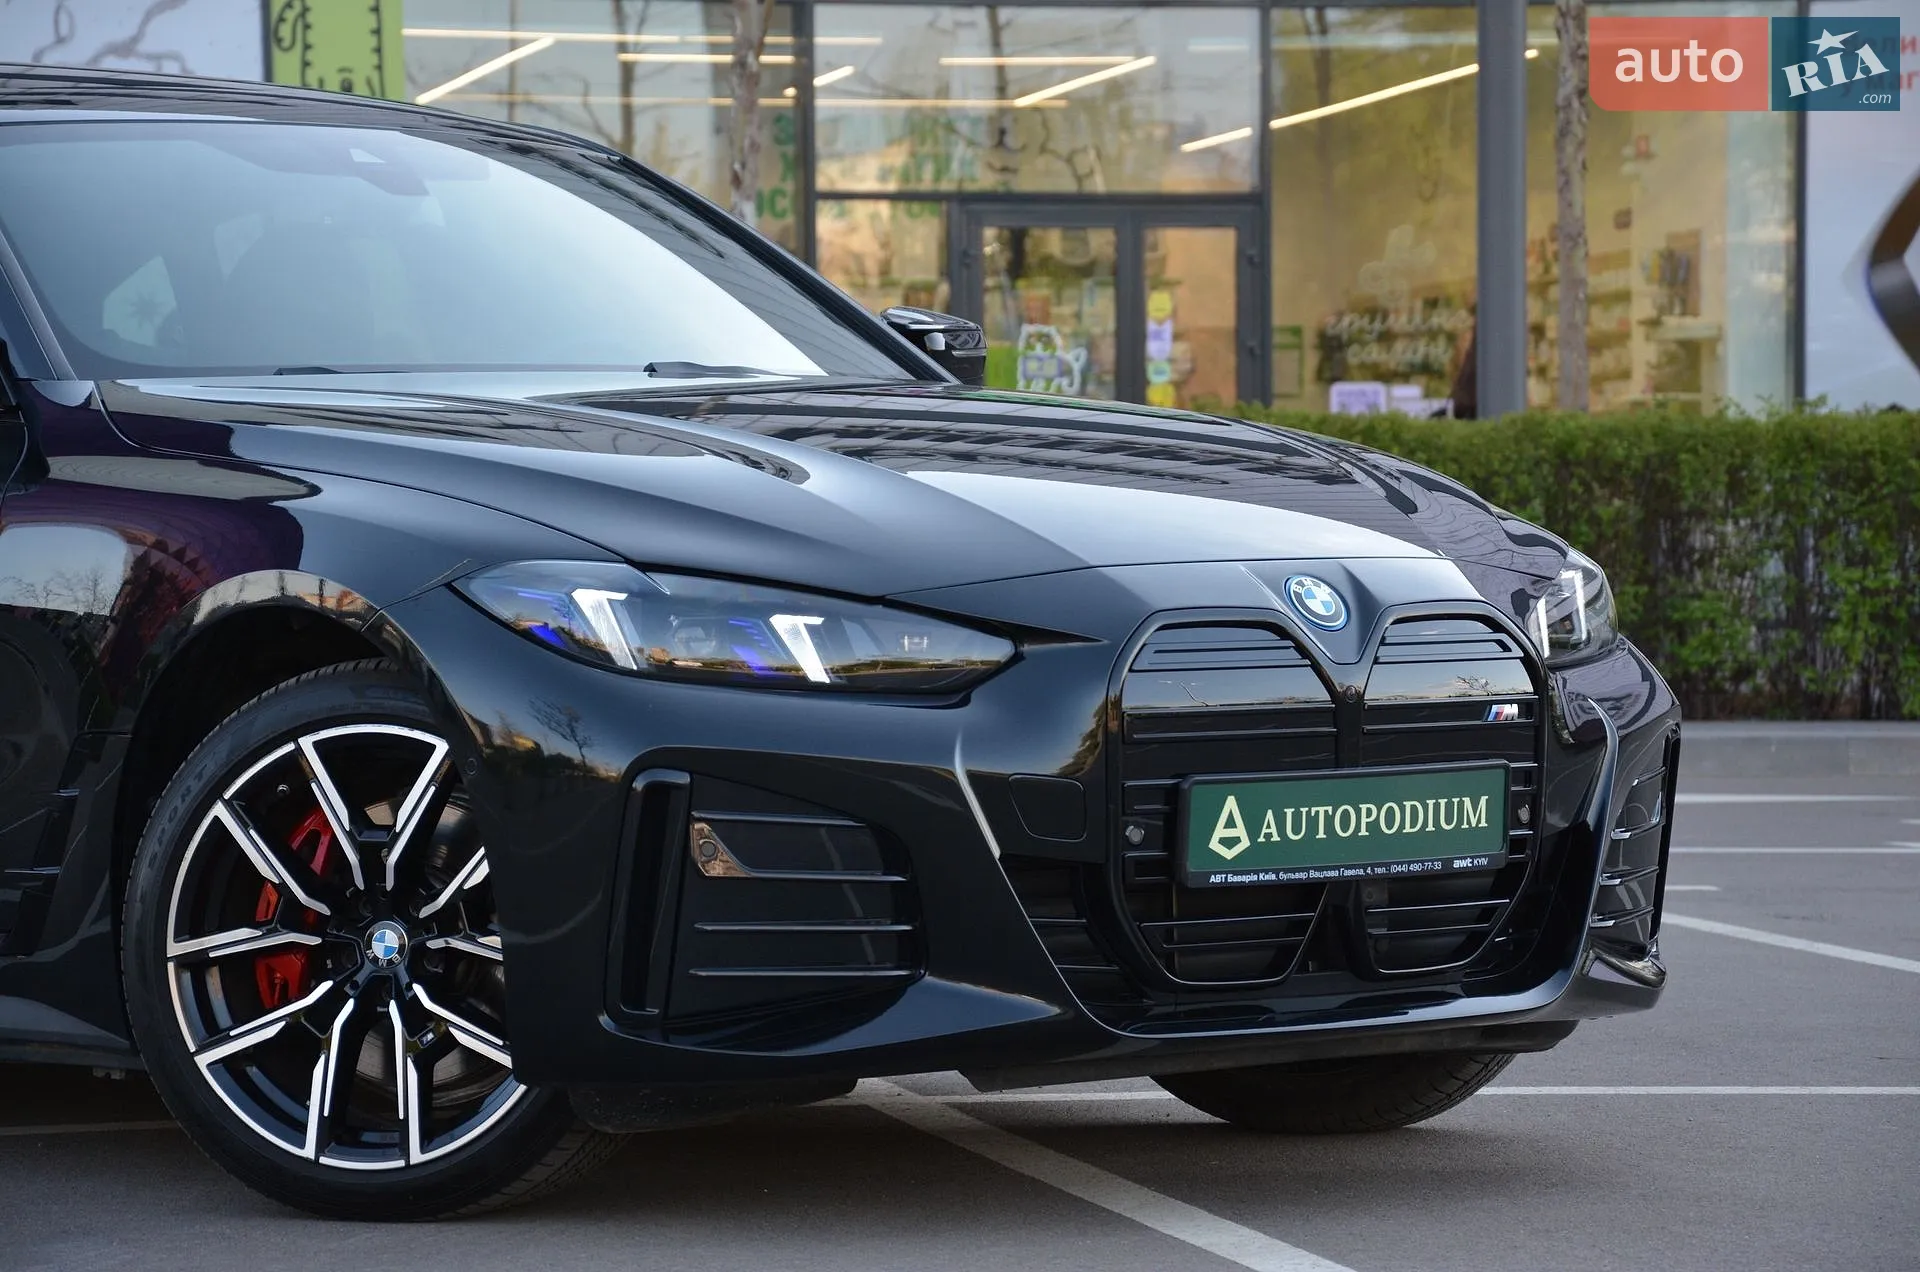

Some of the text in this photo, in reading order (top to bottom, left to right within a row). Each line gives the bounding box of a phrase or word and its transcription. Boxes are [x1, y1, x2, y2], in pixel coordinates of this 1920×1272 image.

[1257, 795, 1489, 843] AUTOPODIUM
[1227, 872, 1258, 884] Баварія
[1279, 871, 1308, 881] бульвар
[1309, 869, 1338, 879] Вацлава
[1390, 864, 1408, 873] (044)
[1409, 861, 1442, 871] 490-77-33
[1473, 857, 1489, 866] KYIV
